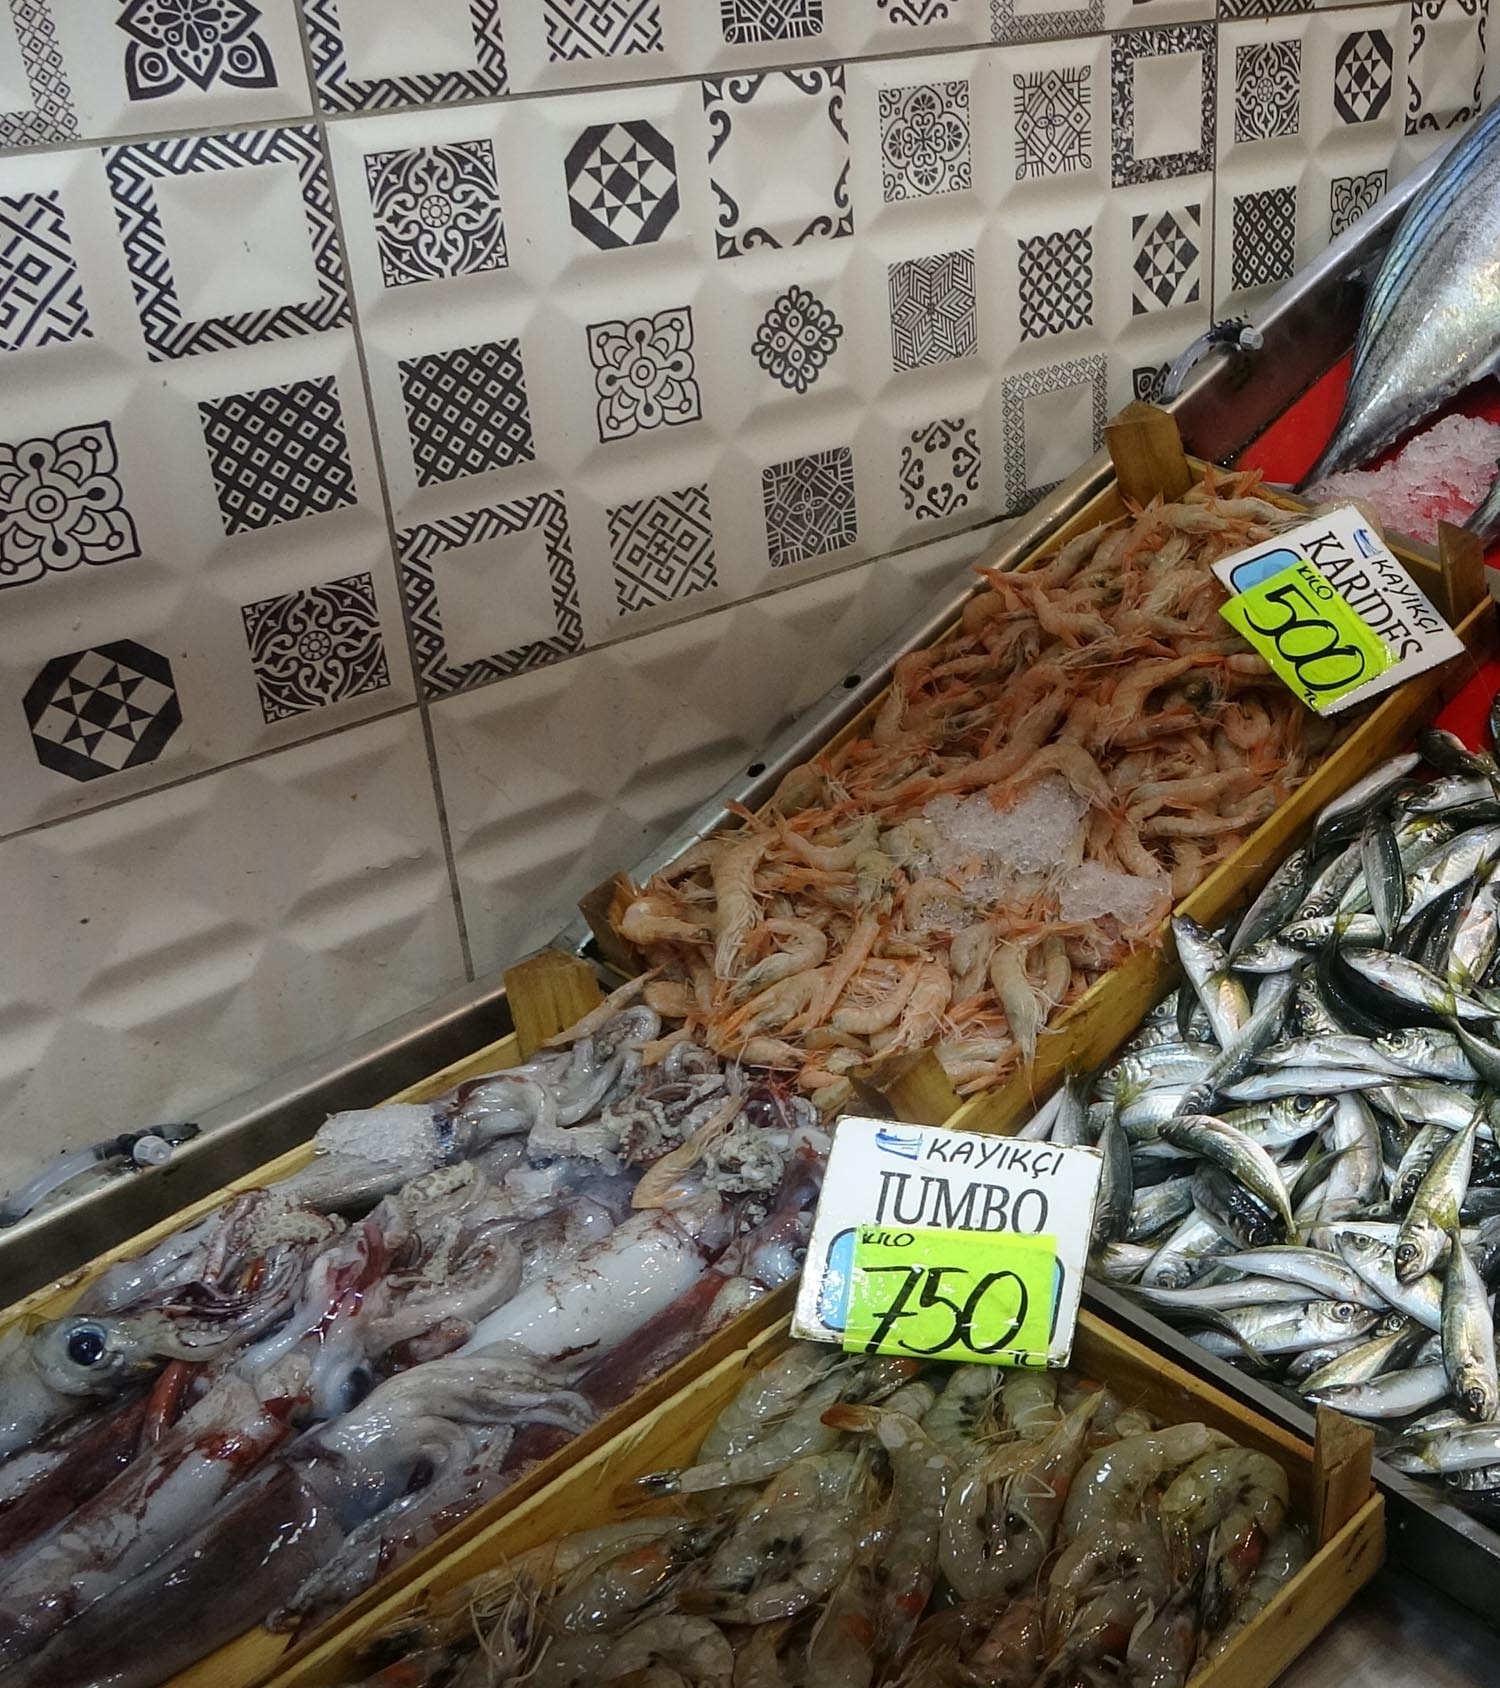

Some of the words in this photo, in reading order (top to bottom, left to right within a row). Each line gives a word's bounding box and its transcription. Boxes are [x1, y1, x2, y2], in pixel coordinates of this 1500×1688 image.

[1371, 559, 1444, 635] KAYIKÇI
[1243, 583, 1366, 692] 500
[925, 1137, 1066, 1180] KAYIKÇI
[868, 1170, 1050, 1236] JUMBO
[861, 1265, 1030, 1356] 750
